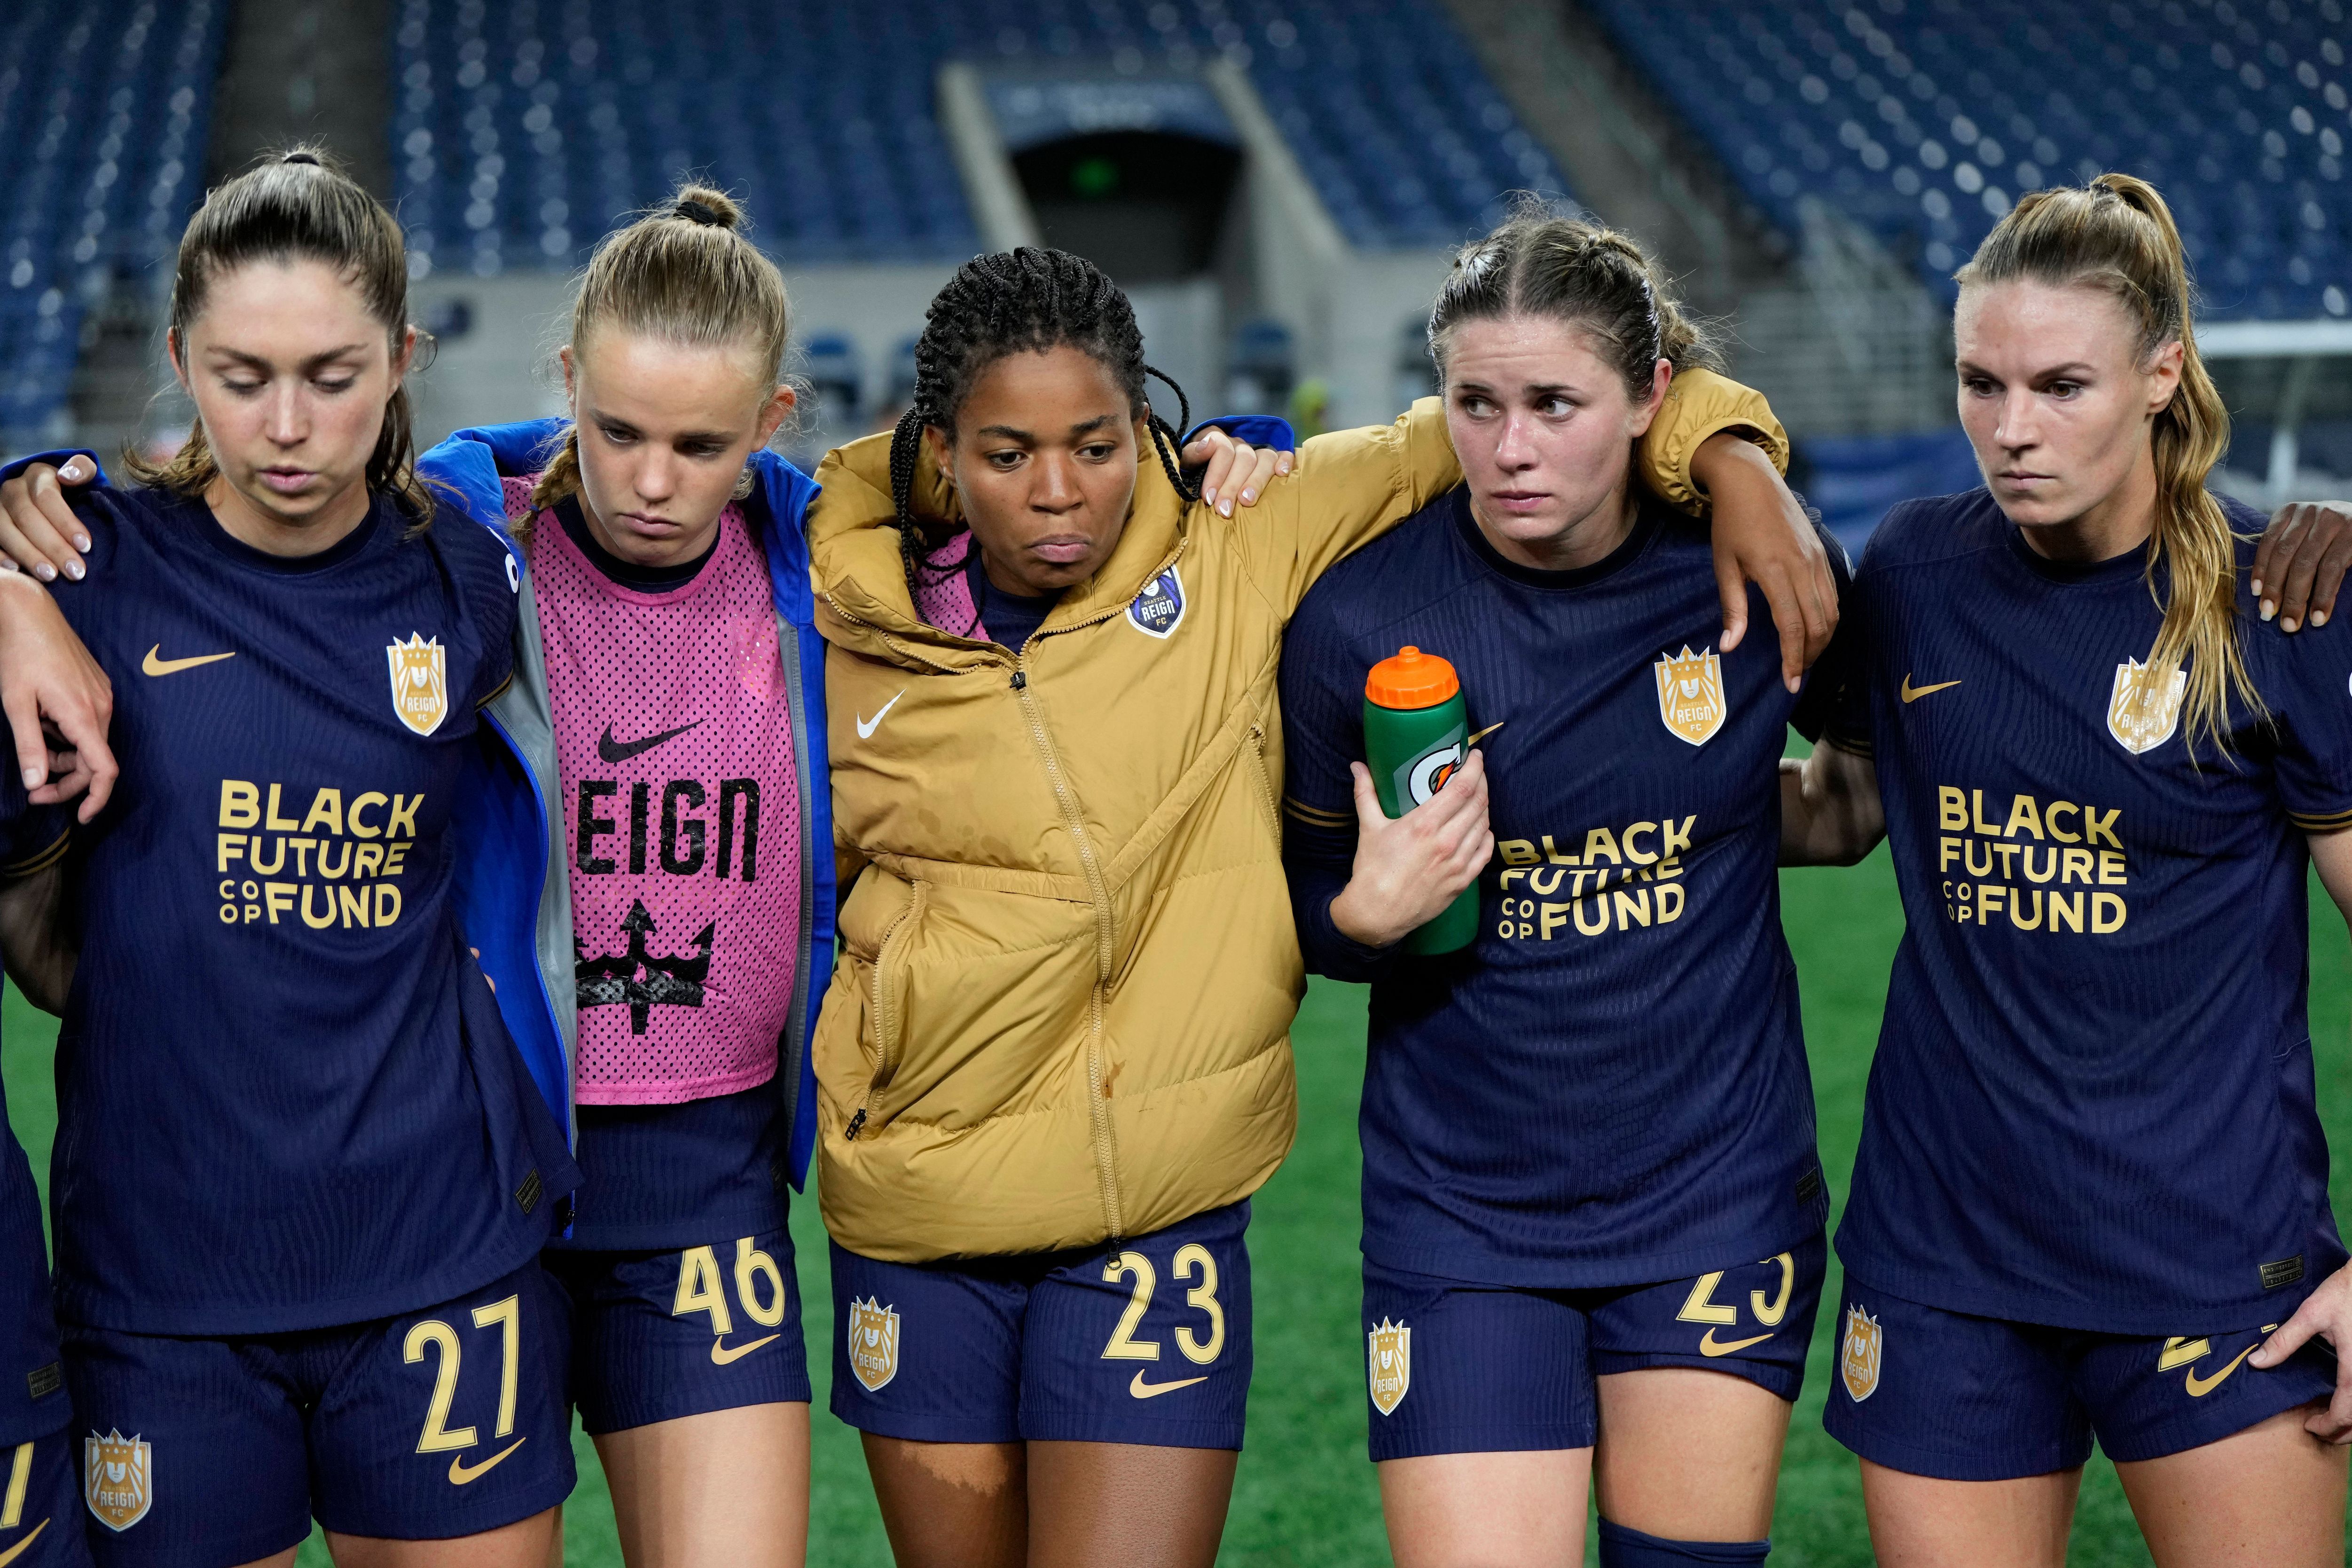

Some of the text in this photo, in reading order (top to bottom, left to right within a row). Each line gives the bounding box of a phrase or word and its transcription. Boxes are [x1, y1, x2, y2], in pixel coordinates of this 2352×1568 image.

[1141, 600, 1175, 621] REIGN
[1144, 596, 1166, 605] SEATTLE
[1156, 617, 1167, 626] FC
[407, 697, 436, 713] REIGN
[1677, 706, 1712, 725] REIGN
[219, 779, 425, 838] BLACK
[1938, 785, 2124, 849] BLACK
[577, 778, 760, 882] EIGN
[1498, 815, 1697, 865] BLACK
[218, 833, 413, 879] FUTURE
[1940, 837, 2127, 885] FUTURE
[219, 879, 259, 900] CO
[1943, 880, 1971, 901] CO
[220, 903, 261, 924] OP
[265, 882, 401, 929] FUND
[1501, 897, 1535, 918] CO
[1540, 883, 1685, 940] FUND
[1947, 903, 1972, 923] OP
[1978, 884, 2127, 933] FUND
[1498, 920, 1533, 940] OP
[672, 1236, 785, 1336] 46
[1100, 1243, 1225, 1365] 23
[403, 1294, 519, 1453] 27
[859, 1353, 884, 1373] REIGN
[1849, 1361, 1868, 1384] REIGN
[1377, 1377, 1398, 1394] REIGN
[100, 1491, 135, 1509] REIGN
